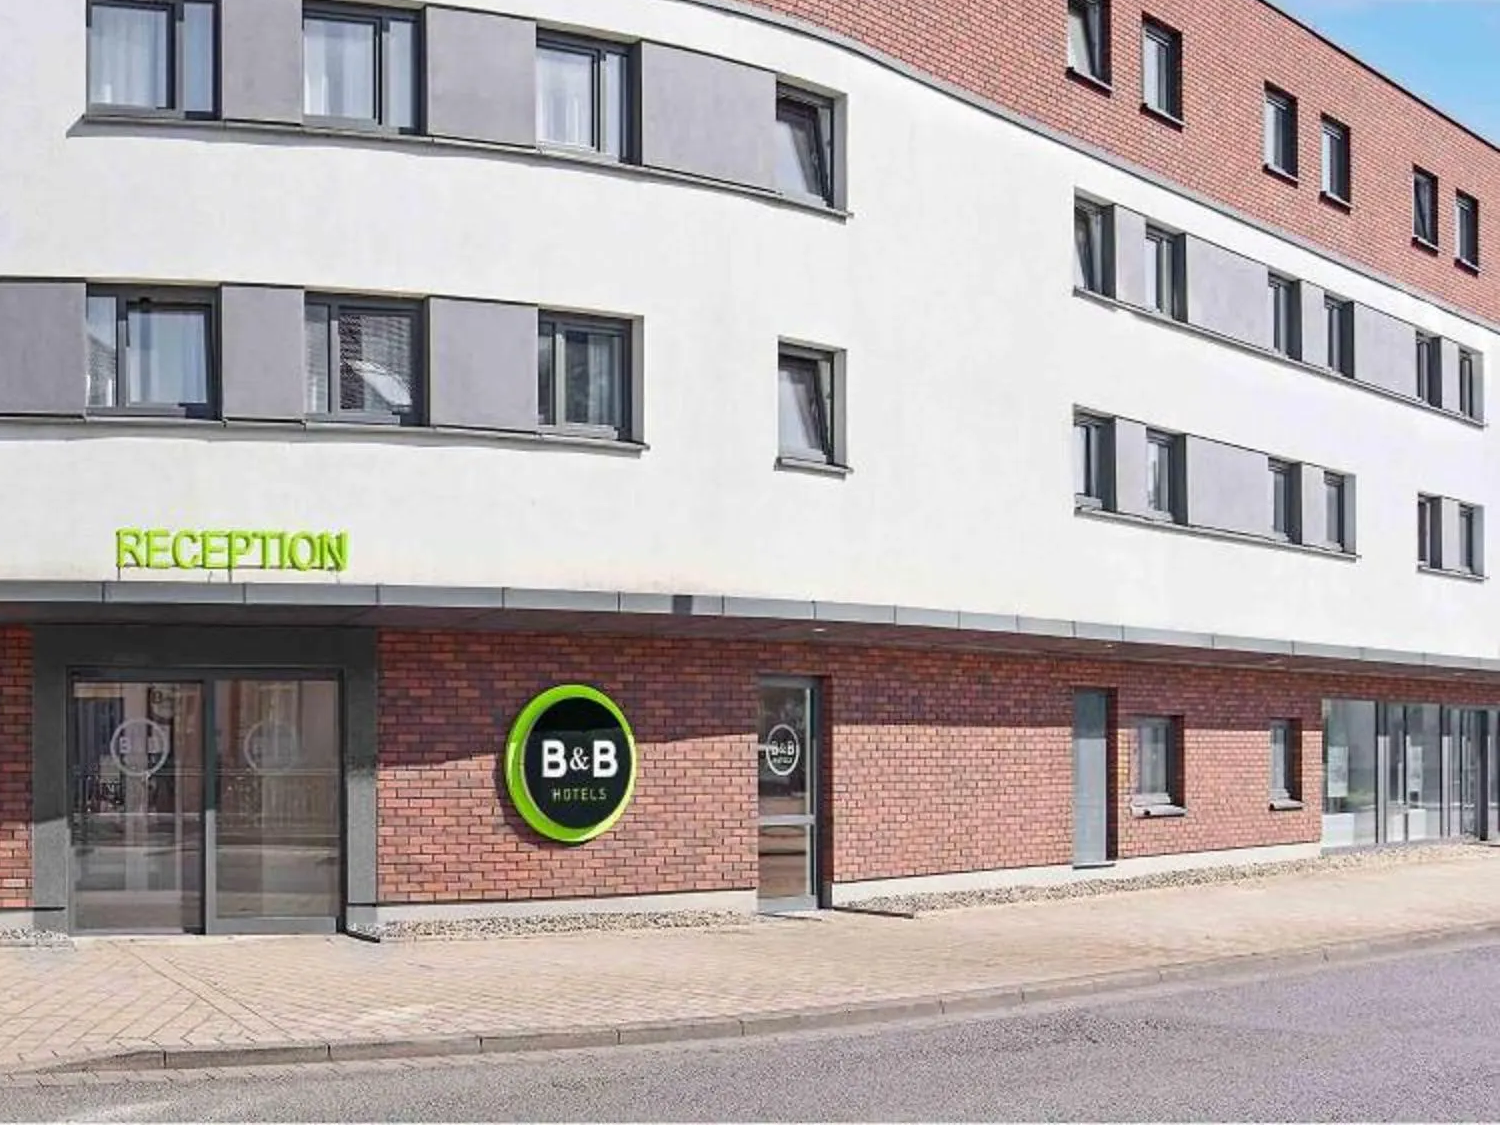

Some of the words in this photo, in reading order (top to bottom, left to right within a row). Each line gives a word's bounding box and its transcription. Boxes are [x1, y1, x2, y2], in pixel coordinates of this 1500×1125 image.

[115, 527, 349, 572] RECEPTION
[541, 739, 619, 778] B&B
[552, 787, 608, 802] HOTELS
